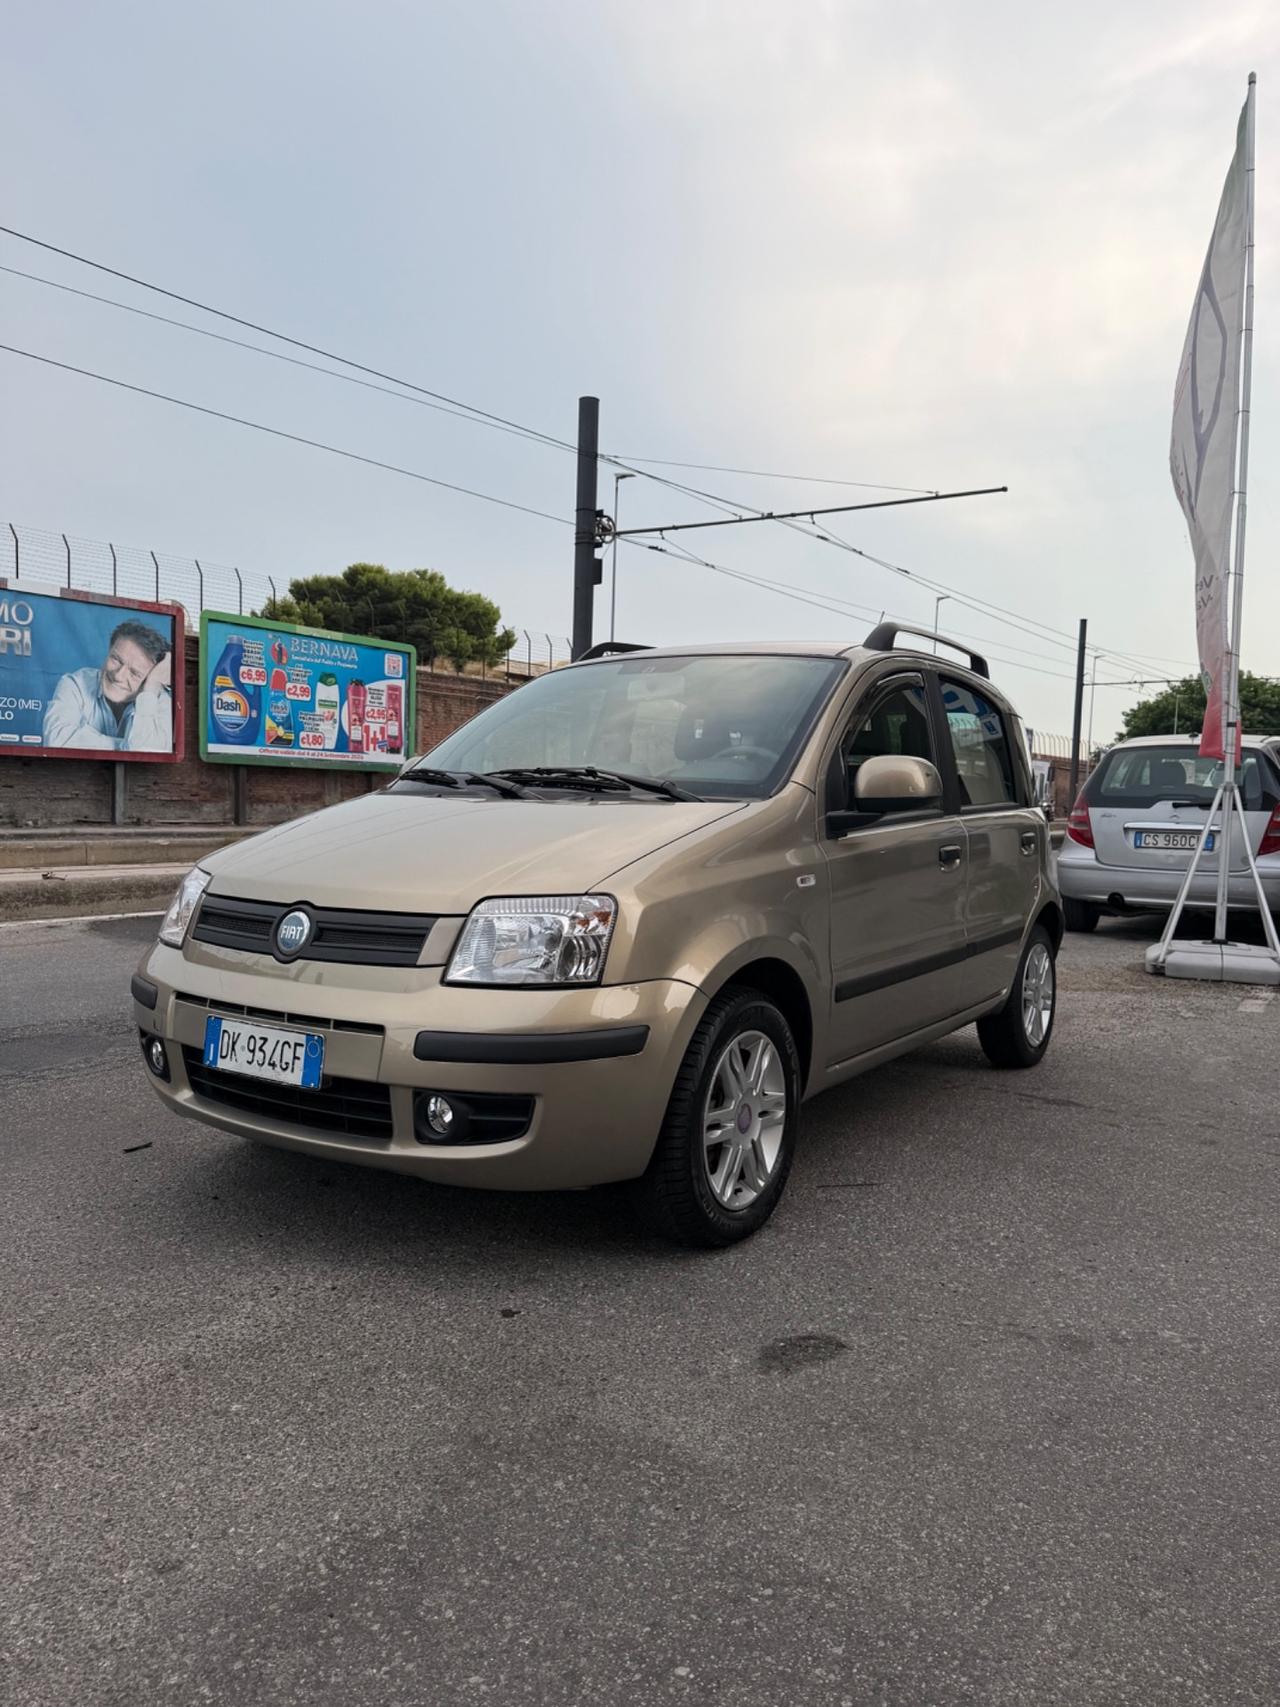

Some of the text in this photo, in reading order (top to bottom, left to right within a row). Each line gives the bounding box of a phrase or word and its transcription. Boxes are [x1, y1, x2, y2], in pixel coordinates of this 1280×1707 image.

[291, 637, 359, 661] BERNAVA
[18, 698, 42, 711] (ME)
[216, 697, 242, 712] Dash
[1143, 834, 1159, 846] CS
[280, 925, 303, 939] FIAT
[220, 1029, 241, 1063] DK
[246, 1034, 305, 1073] 934GF
